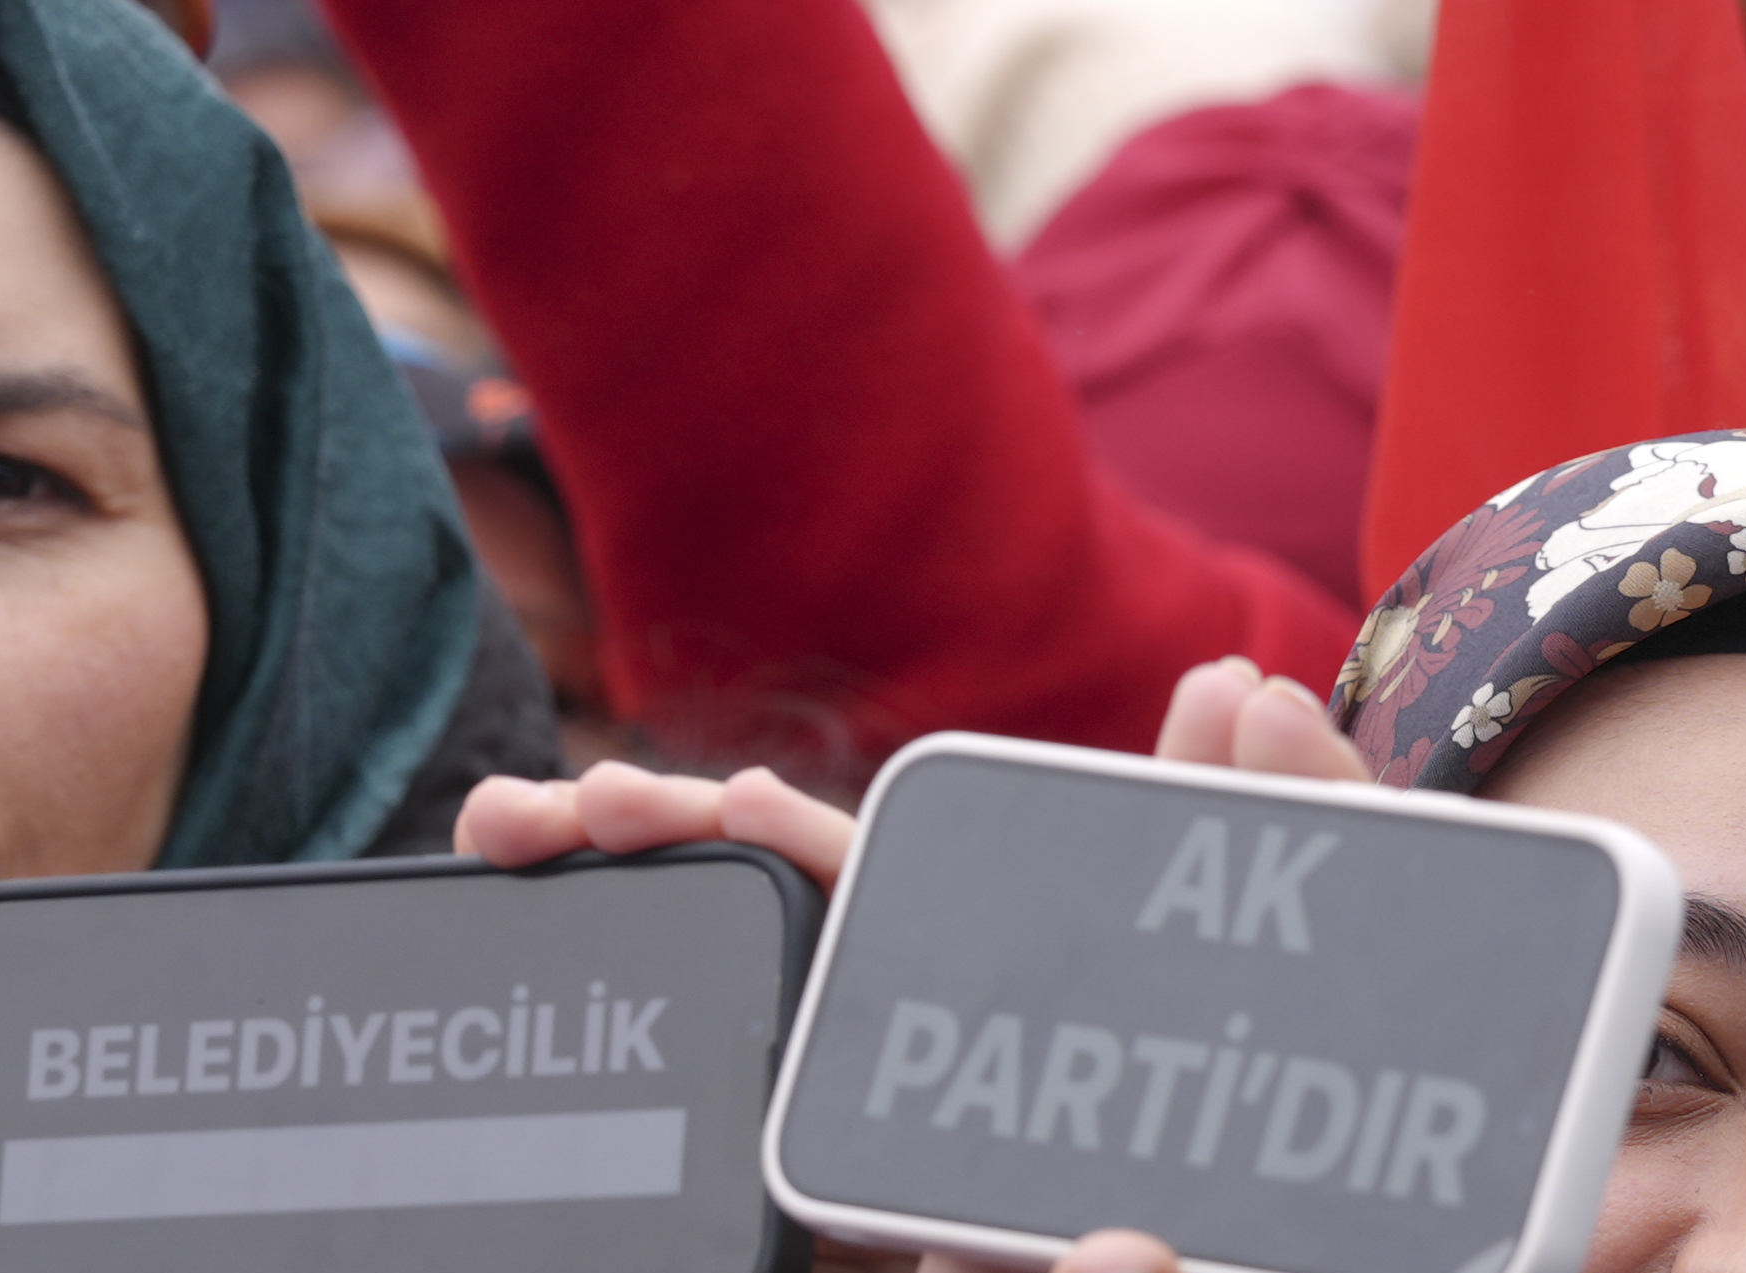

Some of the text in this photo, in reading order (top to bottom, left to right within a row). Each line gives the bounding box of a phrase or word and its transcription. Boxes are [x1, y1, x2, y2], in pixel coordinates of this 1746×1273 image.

[1135, 815, 1342, 955] AK
[25, 980, 669, 1101] BELEDİYECİLİK
[863, 998, 1487, 1207] PARTİ'DIR
